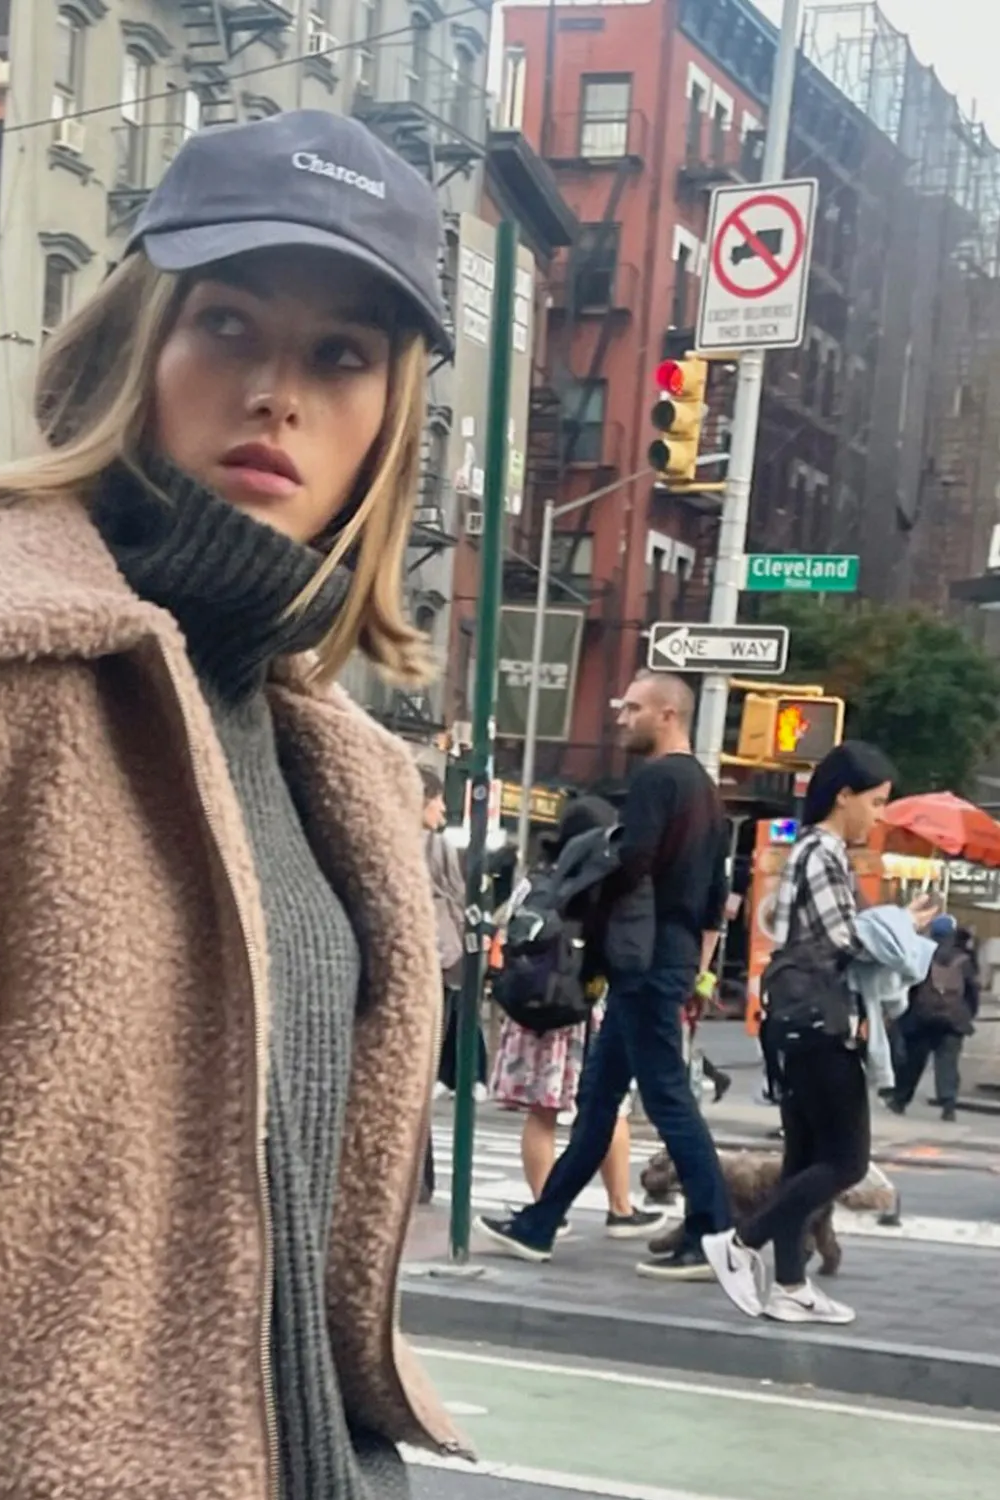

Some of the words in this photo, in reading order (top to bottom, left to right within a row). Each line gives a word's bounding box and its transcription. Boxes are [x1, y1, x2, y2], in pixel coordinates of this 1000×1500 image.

[752, 558, 849, 578] Cleveland
[669, 638, 708, 656] ONE
[729, 641, 773, 658] WAY
